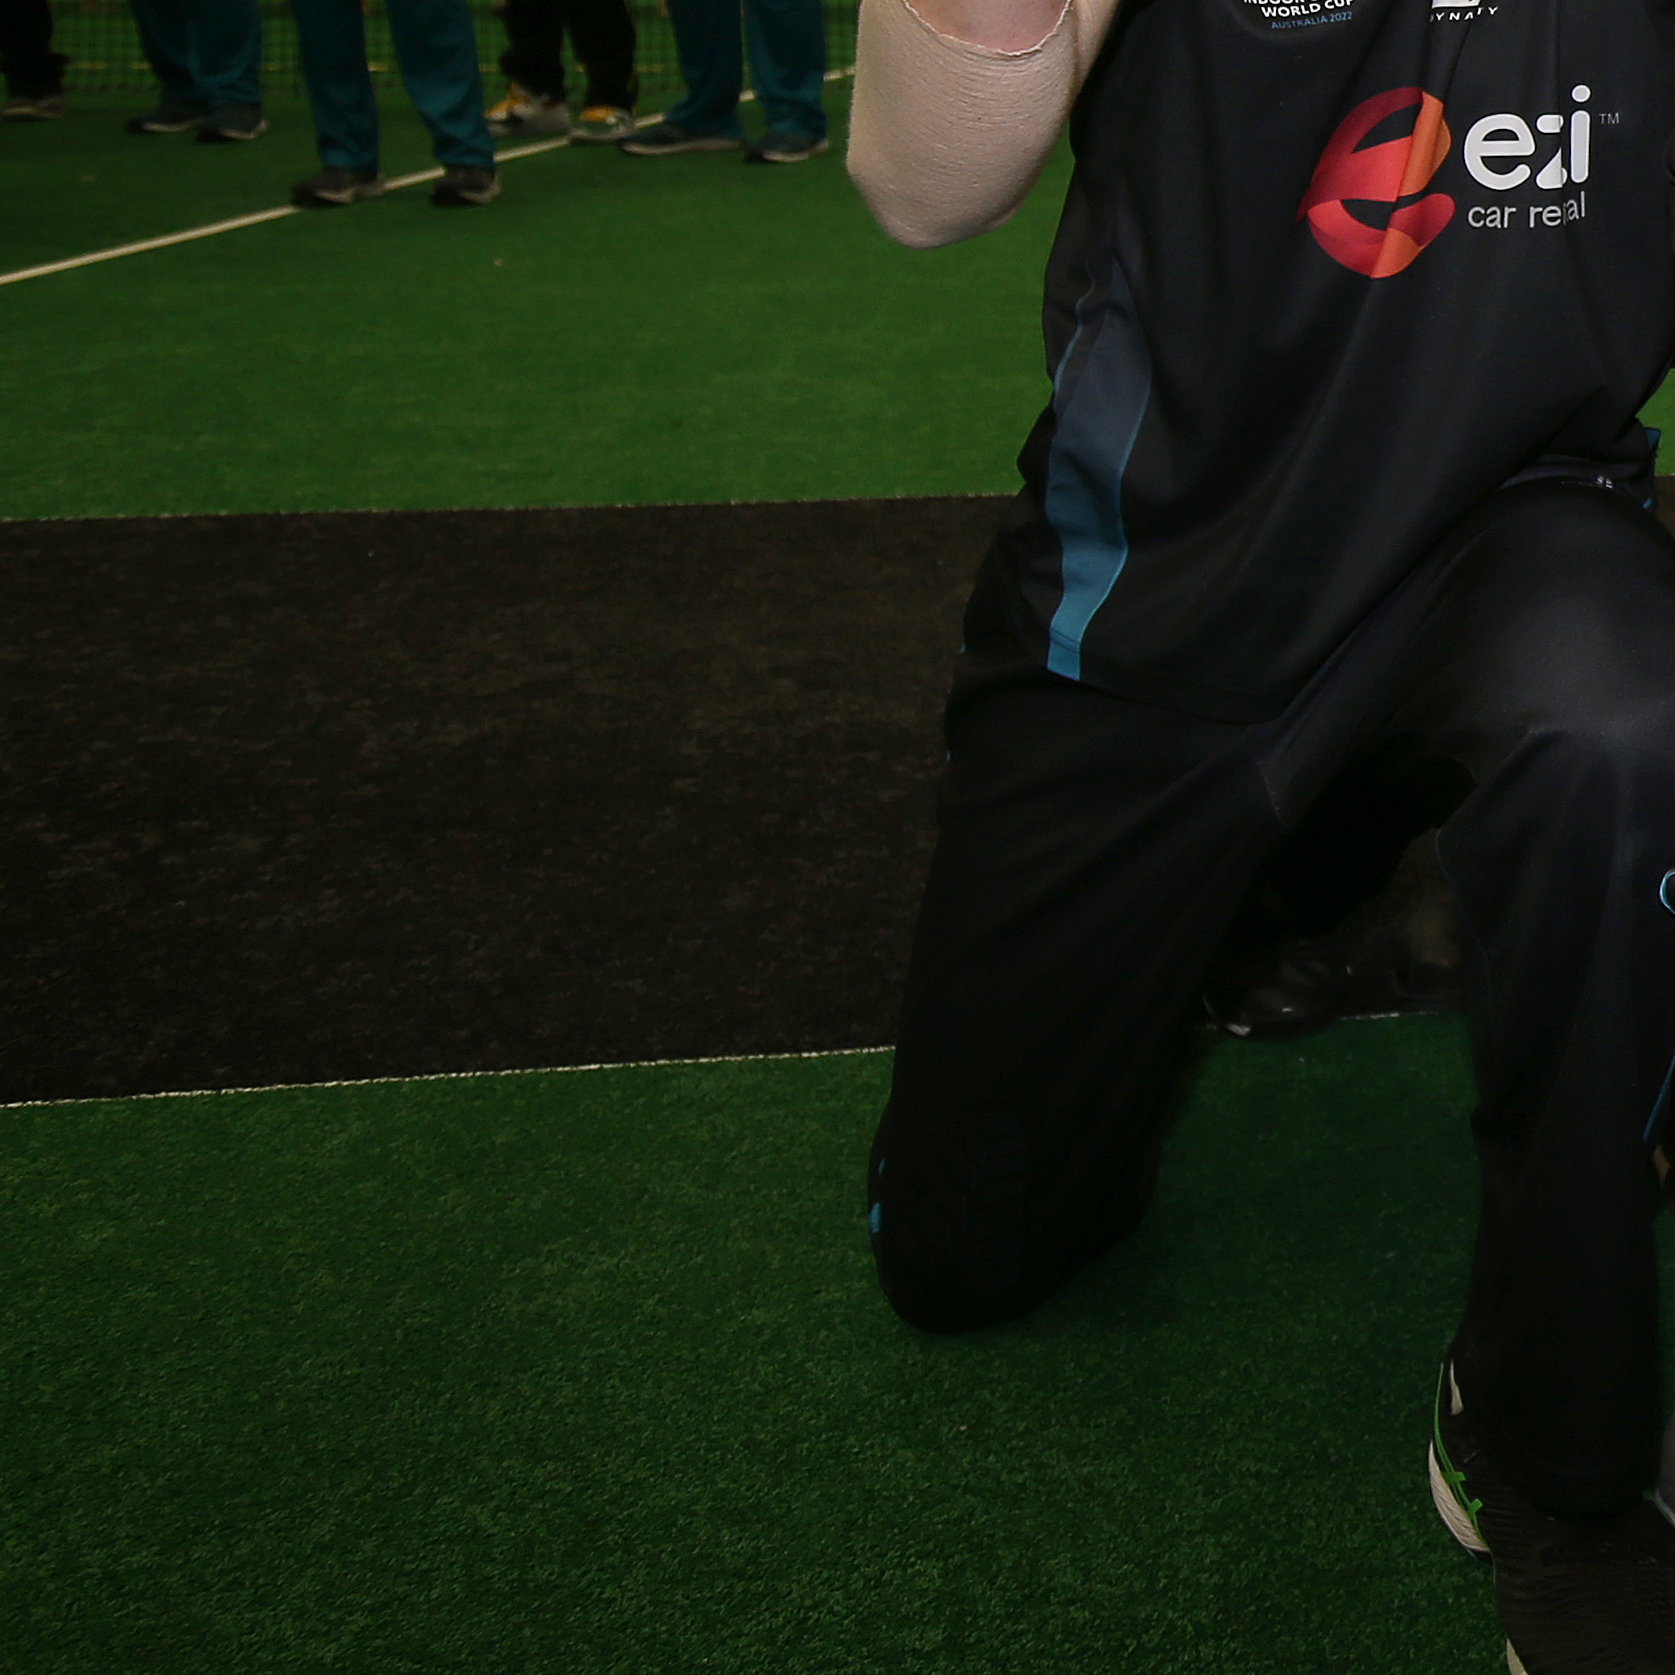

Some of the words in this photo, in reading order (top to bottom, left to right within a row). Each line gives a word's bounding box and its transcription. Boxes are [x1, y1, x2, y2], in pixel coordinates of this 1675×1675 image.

[1261, 3, 1321, 18] WORLD
[1463, 84, 1592, 191] ezi
[1467, 205, 1517, 228] car
